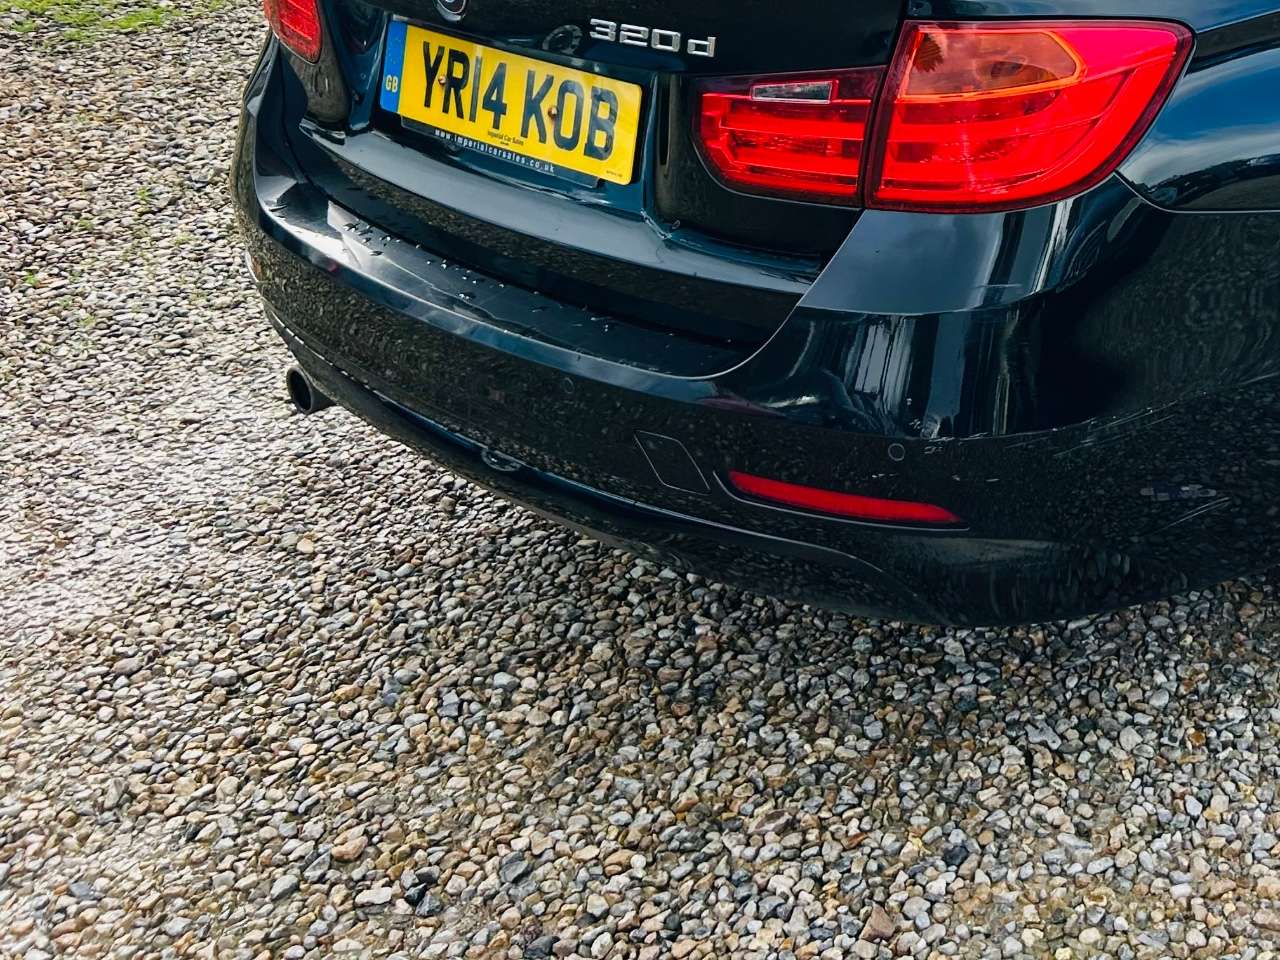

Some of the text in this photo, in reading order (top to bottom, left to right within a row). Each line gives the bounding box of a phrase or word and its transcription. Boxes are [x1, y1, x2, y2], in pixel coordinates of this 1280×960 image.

[385, 74, 399, 93] GB
[423, 41, 619, 161] YR14 KOB
[435, 129, 554, 173] www.imperialcarsales.co.uk
